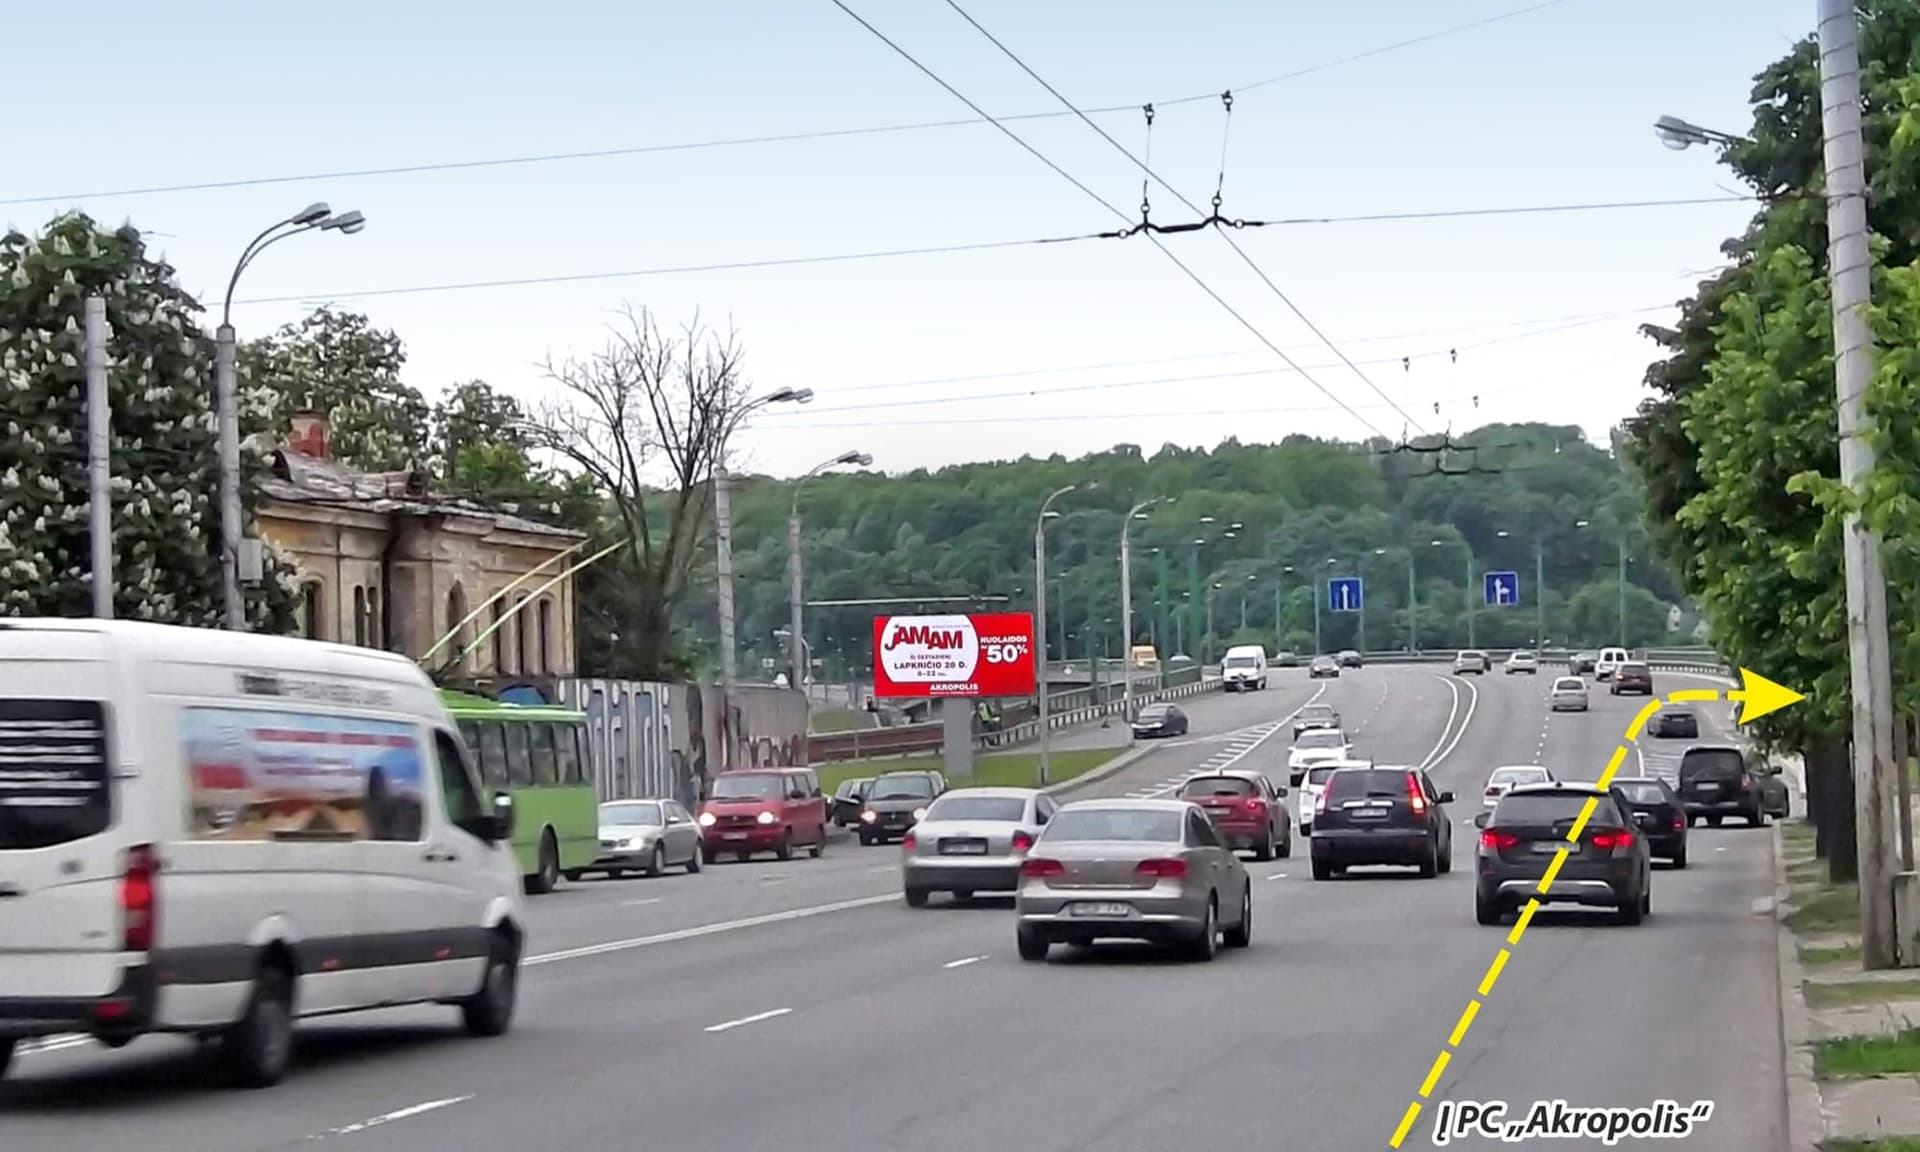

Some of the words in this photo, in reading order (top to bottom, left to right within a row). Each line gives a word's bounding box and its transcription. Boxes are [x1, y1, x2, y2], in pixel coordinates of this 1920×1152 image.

[980, 635, 1028, 644] NUOLAIDOS
[894, 660, 942, 670] LAPKRIČIO
[929, 683, 979, 692] AKROPOLIS
